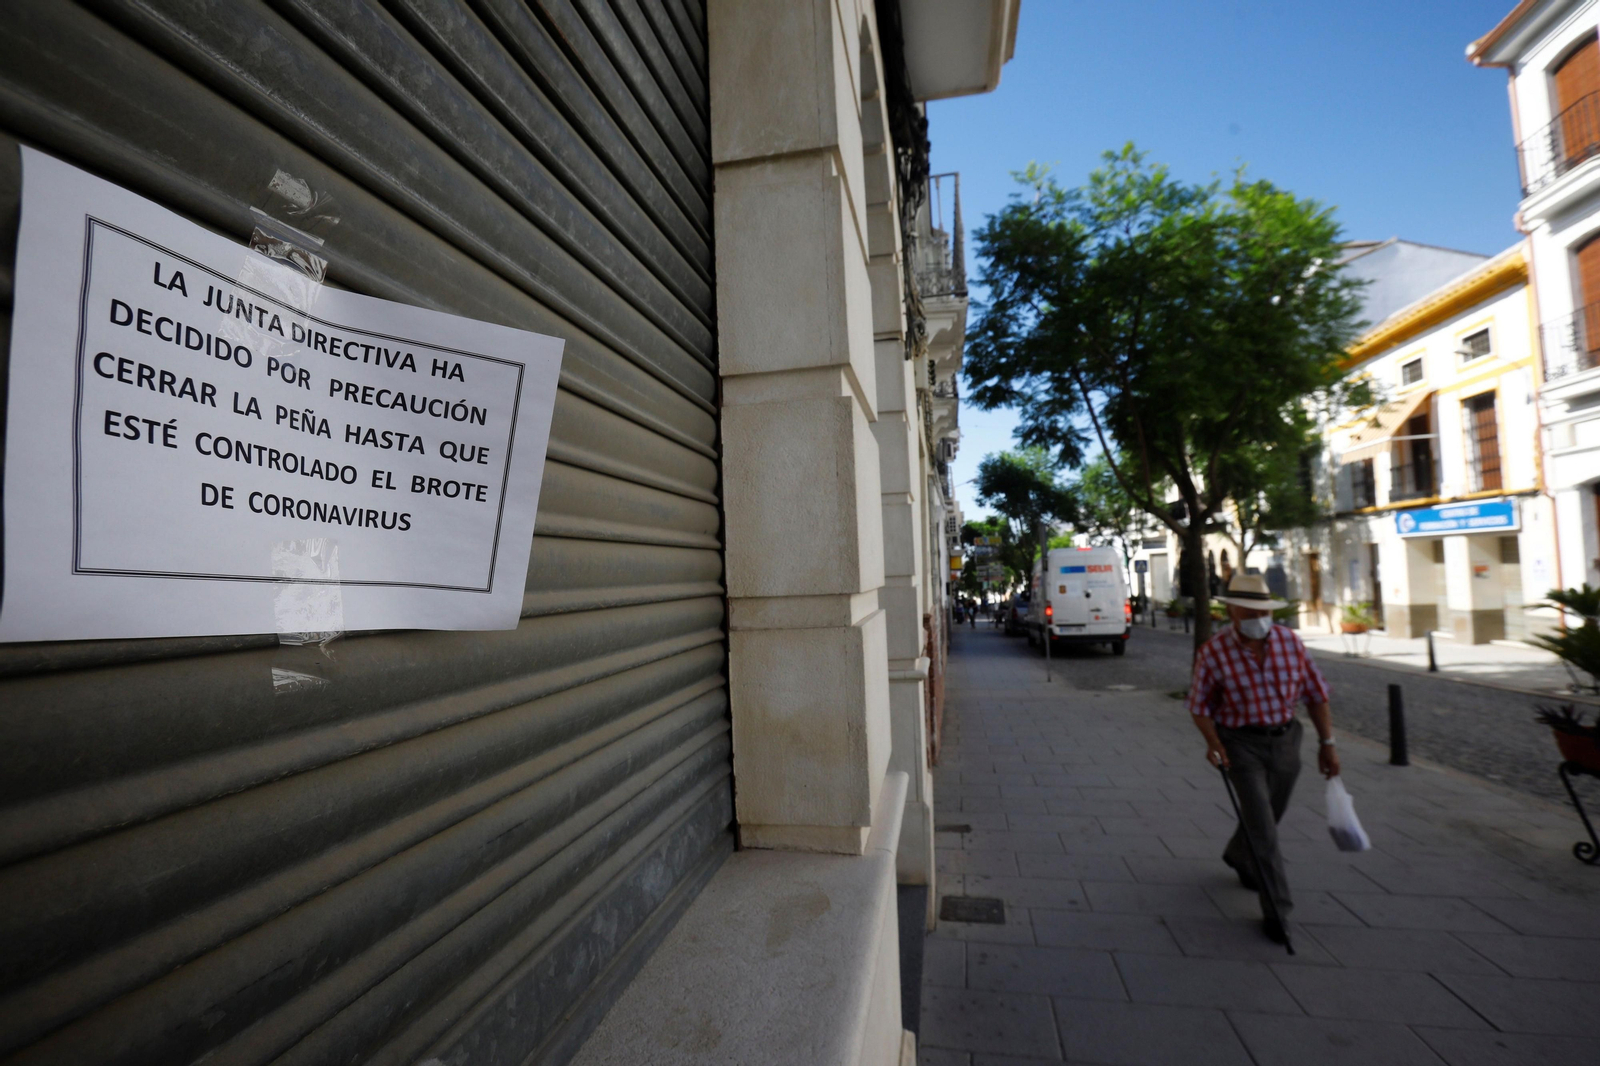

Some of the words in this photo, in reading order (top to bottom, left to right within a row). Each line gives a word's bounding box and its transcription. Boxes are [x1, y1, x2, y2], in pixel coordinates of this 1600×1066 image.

[110, 299, 253, 368] DECIDIDO
[268, 357, 311, 390] POR
[330, 379, 488, 425] PRECAUCIÓN
[154, 262, 188, 298] LA
[203, 286, 285, 337] JUNTA
[292, 322, 417, 373] DIRECTIVA
[431, 359, 465, 382] HA
[93, 352, 217, 408] CERRAR
[234, 392, 262, 420] LA
[276, 405, 332, 439] PEÑA
[345, 424, 425, 454] HASTA
[440, 441, 490, 465] QUE
[105, 410, 178, 449] ESTÉ
[196, 433, 358, 485] CONTROLADO
[372, 470, 397, 490] EL
[411, 475, 489, 503] BROTE
[202, 483, 235, 510] DE
[249, 492, 412, 532] CORONAVIRUS
